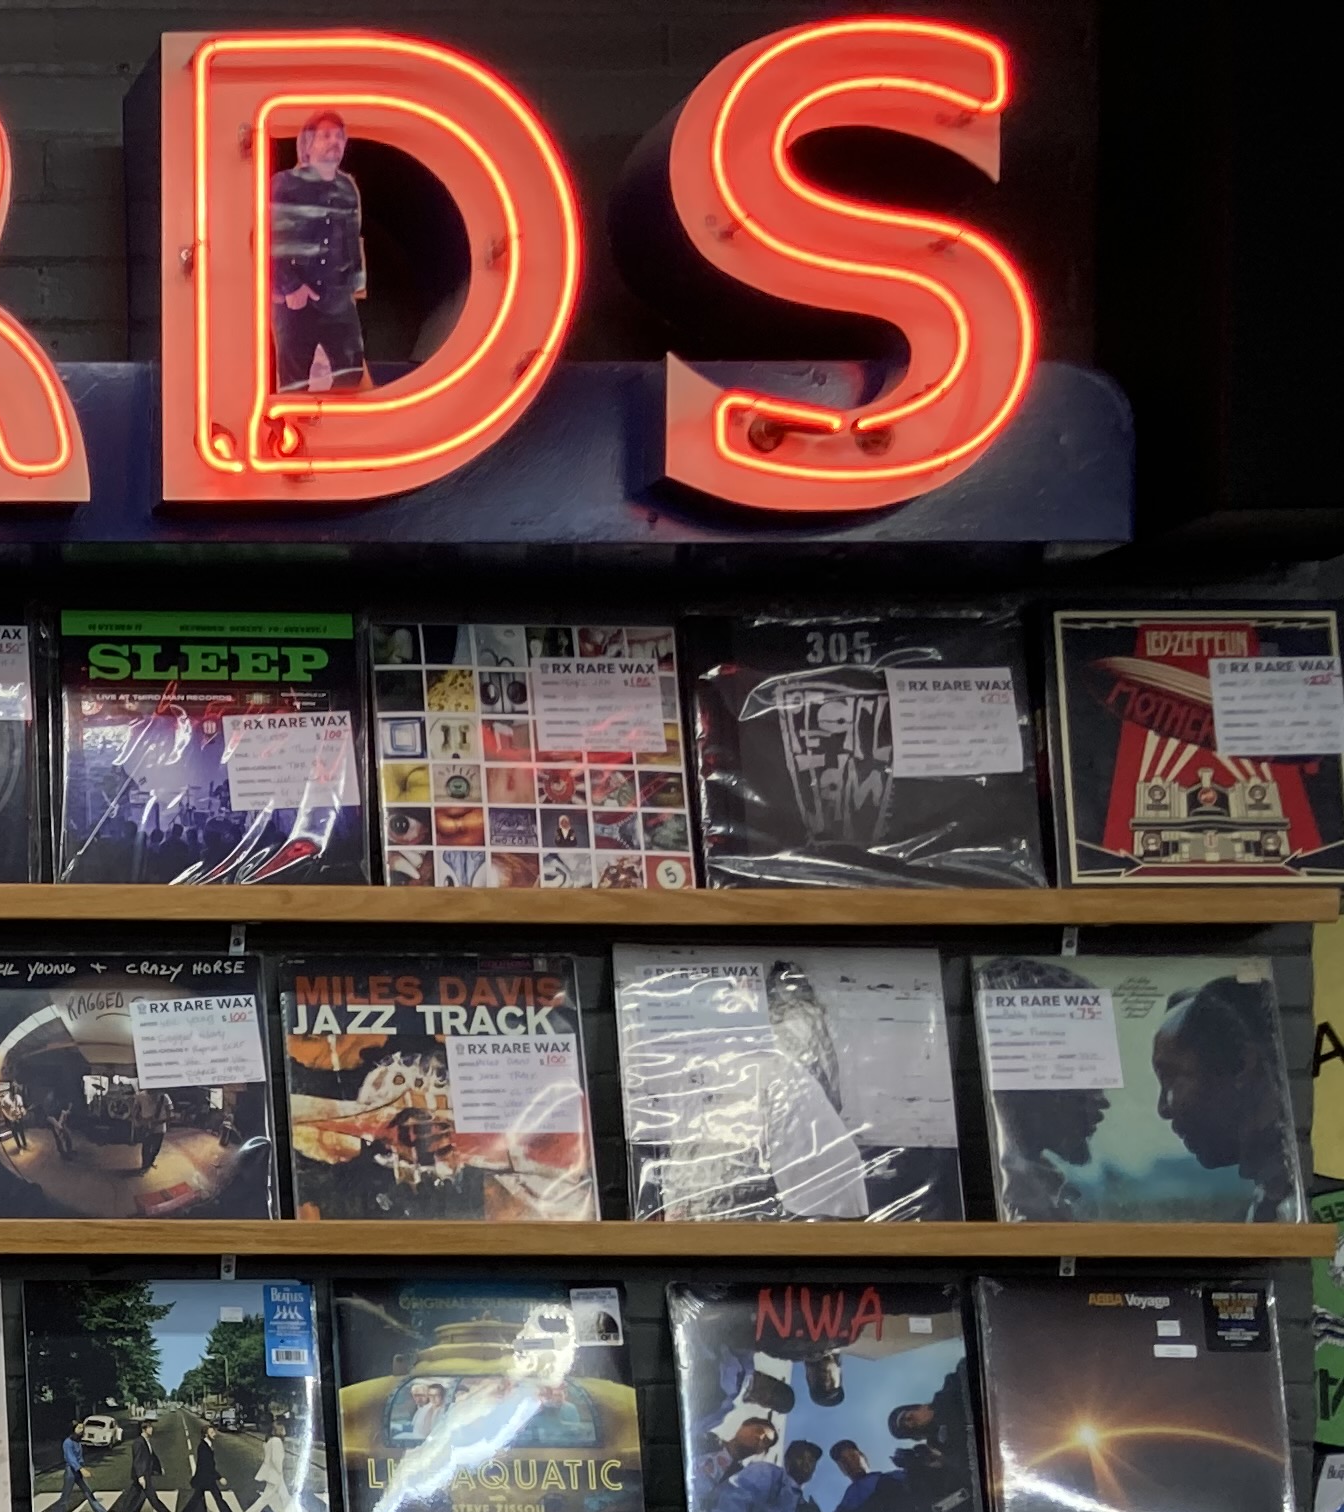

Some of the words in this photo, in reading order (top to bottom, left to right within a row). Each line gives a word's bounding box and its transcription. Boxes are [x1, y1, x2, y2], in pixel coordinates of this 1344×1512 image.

[807, 631, 876, 663] 305
[88, 643, 329, 681] SLEEP
[28, 962, 76, 981] YOUNG
[126, 962, 182, 982] CRAZY
[192, 961, 245, 974] HORSE
[295, 977, 423, 1005] MILES
[440, 976, 566, 1004] DAVIS
[293, 1005, 396, 1034] JAZZ
[416, 1005, 554, 1034] TRACK
[468, 1044, 486, 1054] RX
[492, 1044, 529, 1054] RARE
[533, 1043, 570, 1054] WAX
[1125, 1294, 1170, 1309] Voyage
